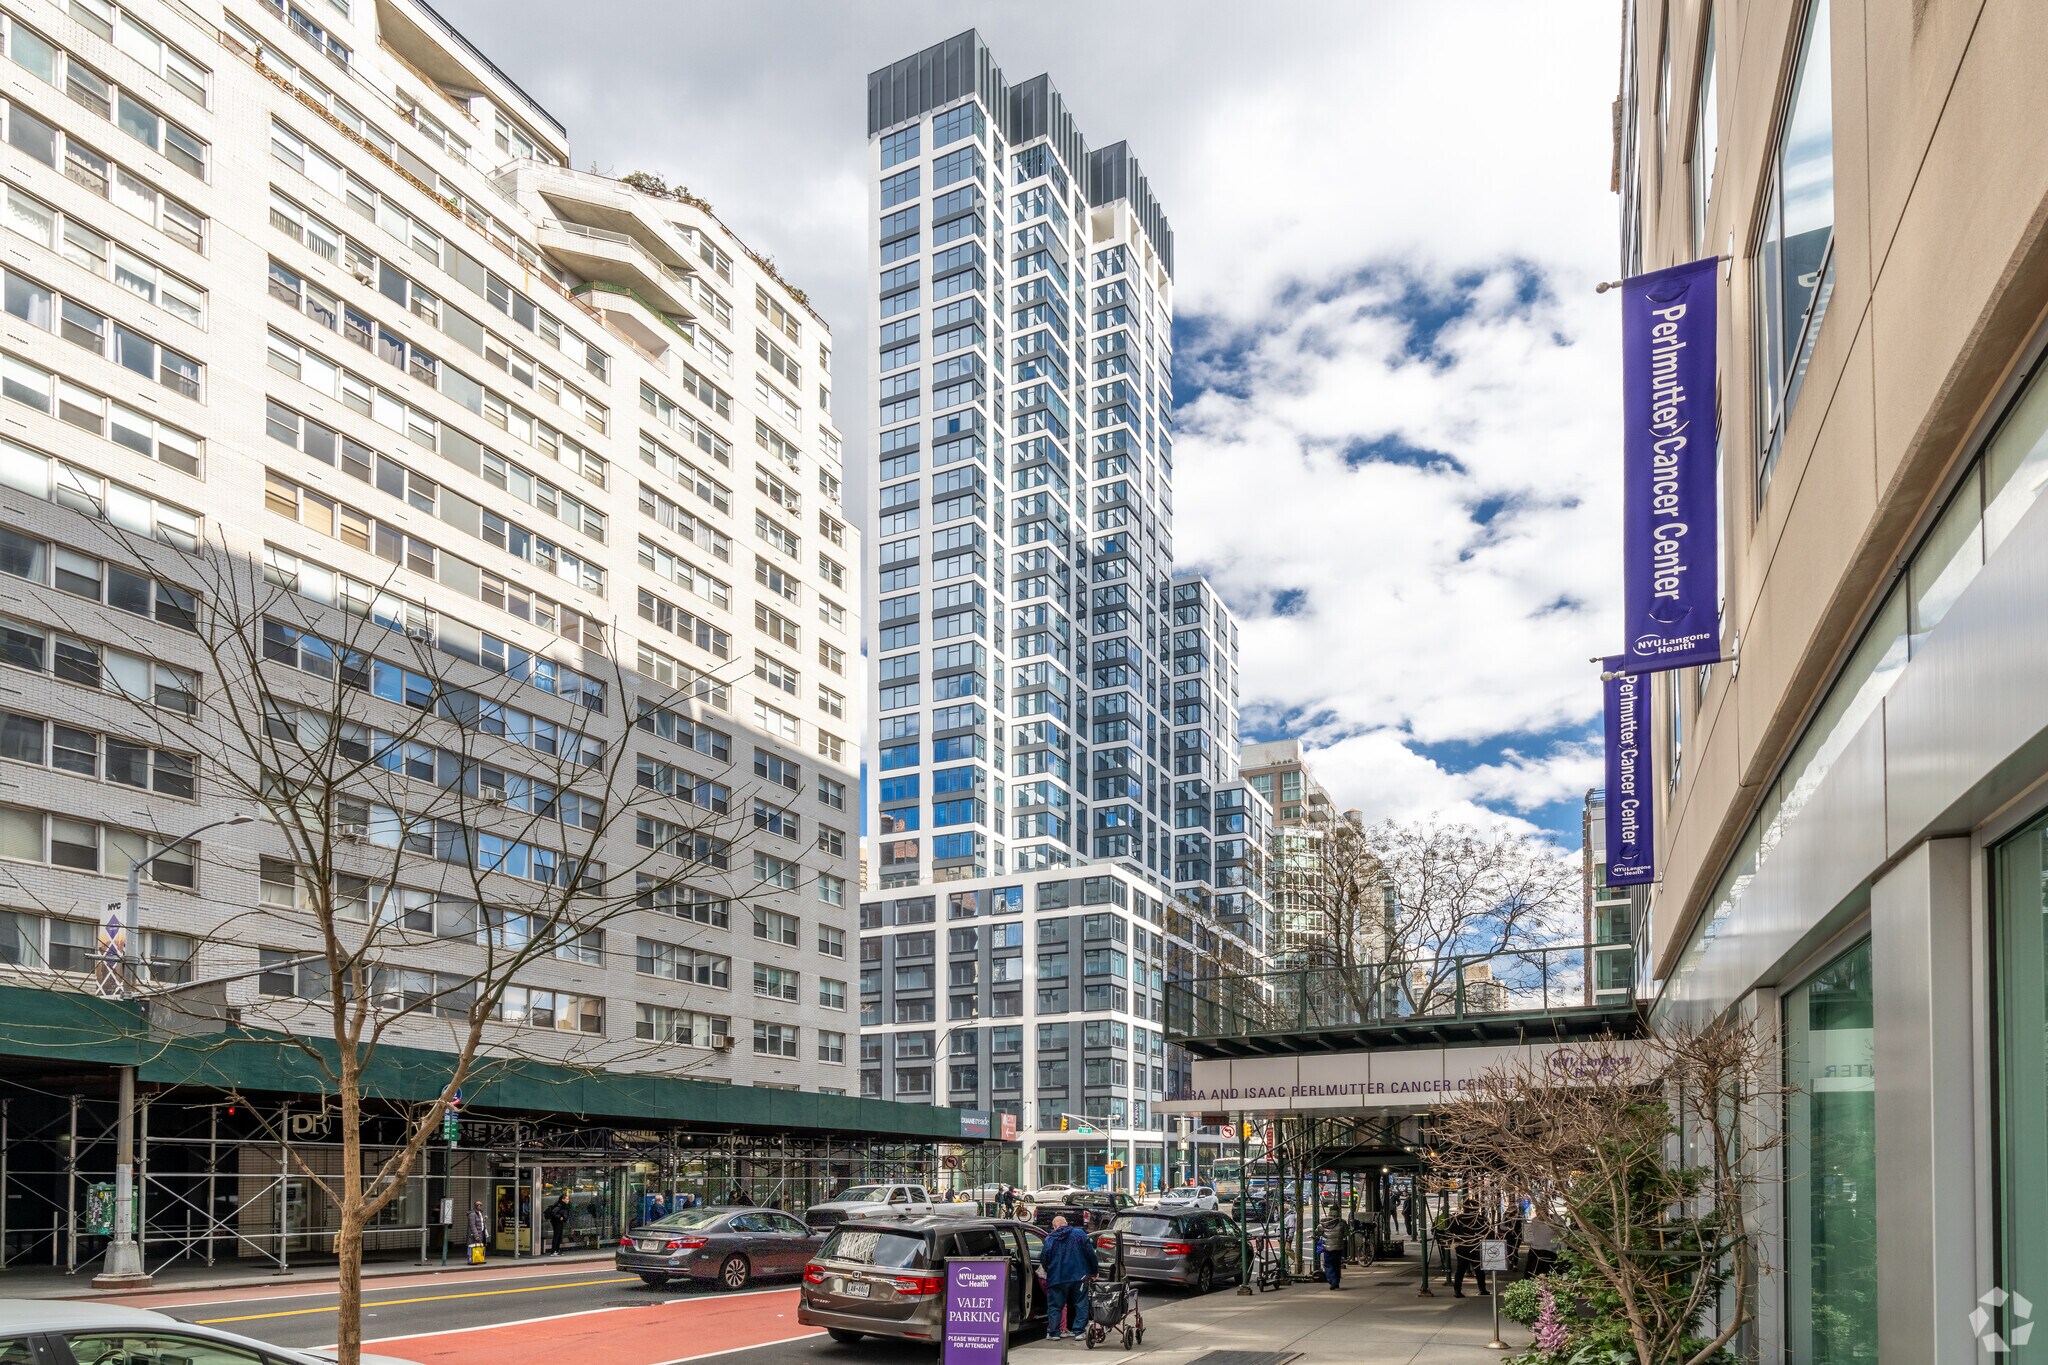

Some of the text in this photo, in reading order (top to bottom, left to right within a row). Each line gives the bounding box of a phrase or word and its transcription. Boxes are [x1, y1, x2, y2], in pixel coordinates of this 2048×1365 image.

[1652, 304, 1688, 600] Perlmutter Cancer Center
[1638, 633, 1710, 649] NYU Langone
[1658, 642, 1695, 653] Health
[1620, 674, 1640, 845] Perlmutter Cancer Center
[107, 902, 122, 911] NYC
[1164, 1089, 1206, 1102] LAURA
[1211, 1088, 1239, 1100] AND
[1244, 1086, 1286, 1099] ISAAC
[1291, 1082, 1385, 1097] PERLMUTTER
[1390, 1079, 1451, 1094] CANCER
[972, 1273, 997, 1282] Langone
[969, 1280, 989, 1288] Health
[957, 1298, 994, 1309] VALET
[949, 1311, 1001, 1323] PARKING
